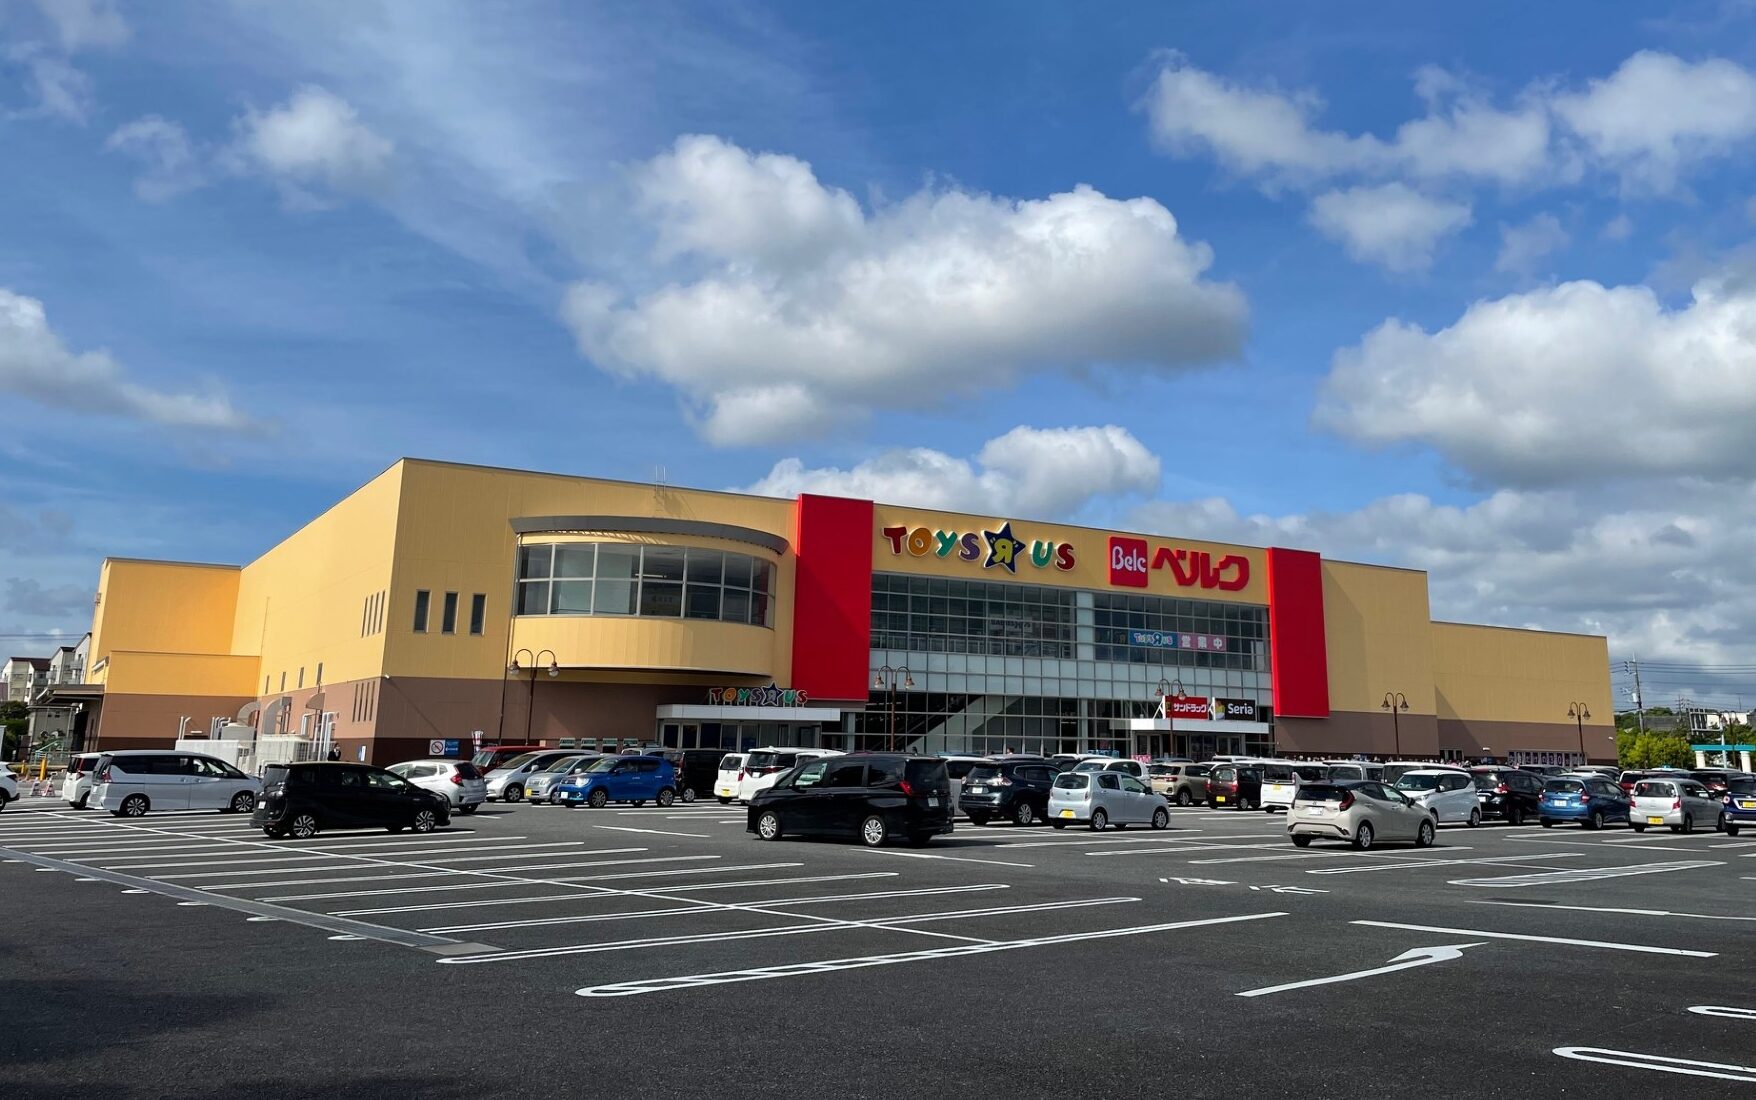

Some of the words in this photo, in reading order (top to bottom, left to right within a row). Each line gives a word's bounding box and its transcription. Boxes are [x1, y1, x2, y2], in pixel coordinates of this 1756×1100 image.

[1112, 545, 1147, 573] Belc
[1151, 547, 1250, 591] ベルク
[1173, 703, 1207, 713] サンドラッグ
[1227, 703, 1254, 715] Seria
